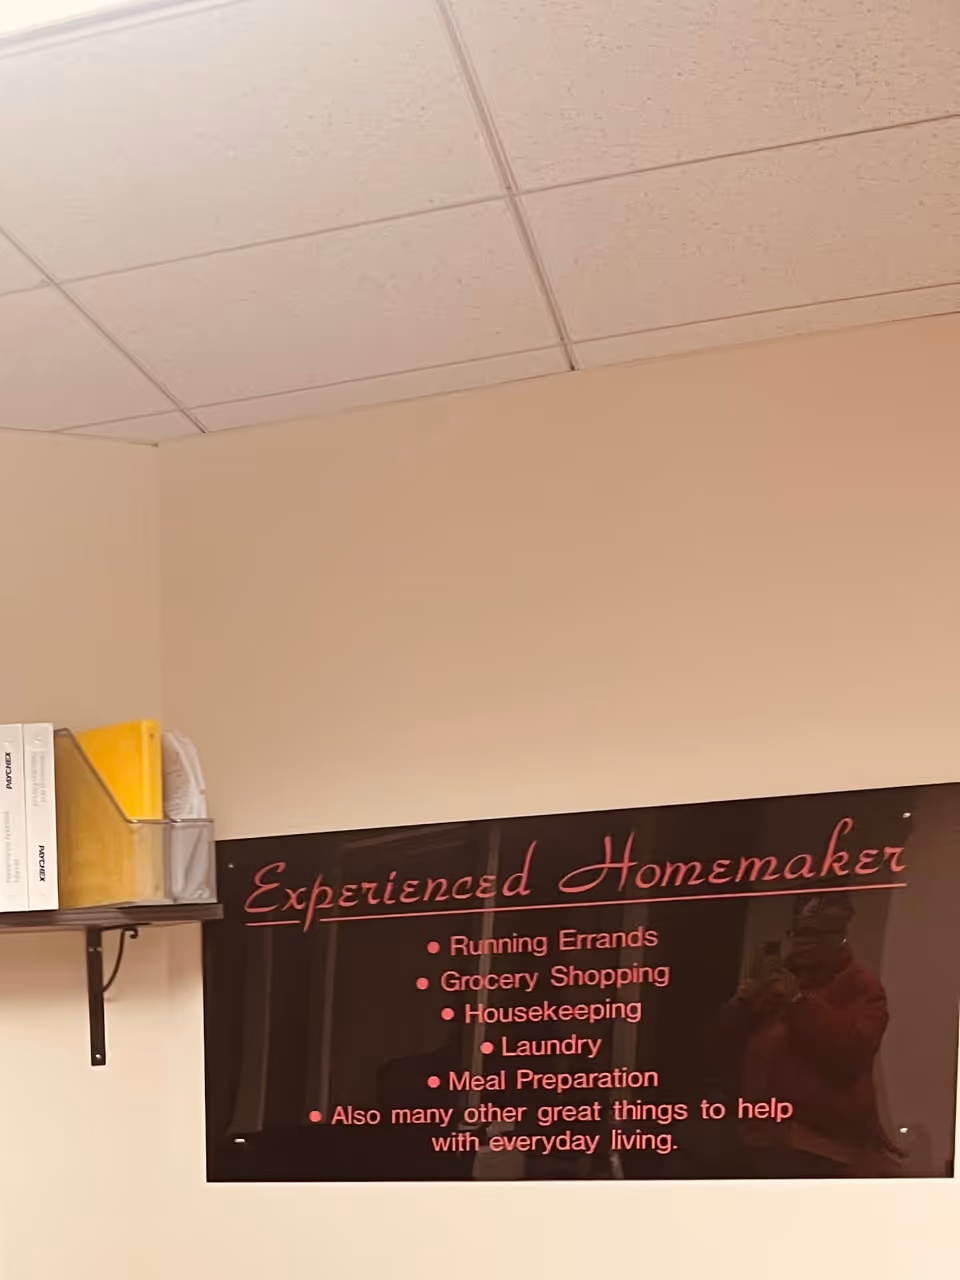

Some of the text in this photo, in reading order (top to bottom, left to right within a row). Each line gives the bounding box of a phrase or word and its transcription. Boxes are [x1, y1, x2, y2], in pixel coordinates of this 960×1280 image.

[5, 751, 13, 789] PAYCHEX
[38, 845, 46, 882] PAYCHEX
[245, 817, 906, 931] Experienced Homemaker
[450, 928, 658, 957] Running Errands
[440, 963, 670, 993] Grocery Shopping
[465, 1001, 642, 1024] Housekeeping
[501, 1033, 602, 1058] Laundry
[449, 1068, 659, 1094] Meal Preparation
[331, 1097, 794, 1127] Also many other great things to help
[431, 1130, 679, 1155] with everyday living.
